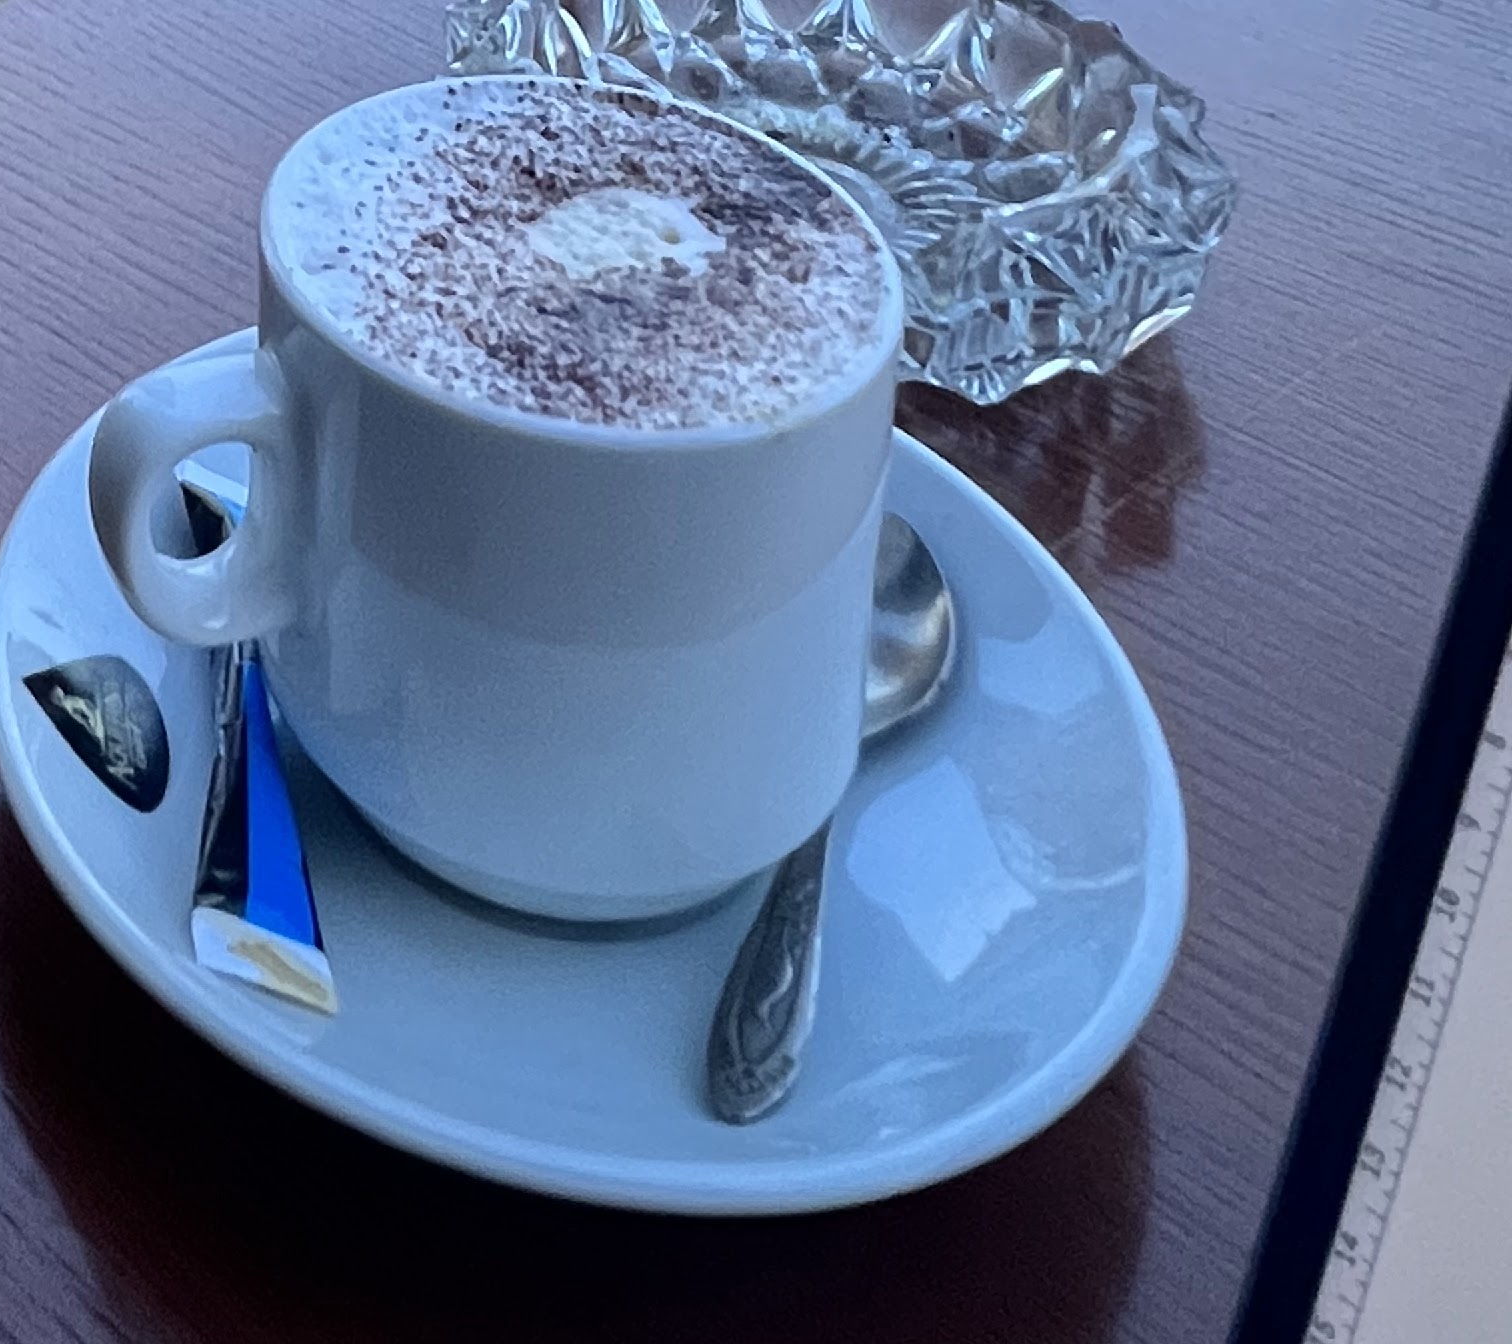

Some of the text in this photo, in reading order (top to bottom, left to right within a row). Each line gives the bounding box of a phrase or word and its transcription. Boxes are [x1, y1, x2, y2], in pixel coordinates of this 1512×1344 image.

[1435, 887, 1461, 923] 10
[1410, 975, 1435, 1007] 11
[1386, 1056, 1412, 1091] 12
[1360, 1143, 1386, 1179] 13
[1334, 1230, 1359, 1267] 14
